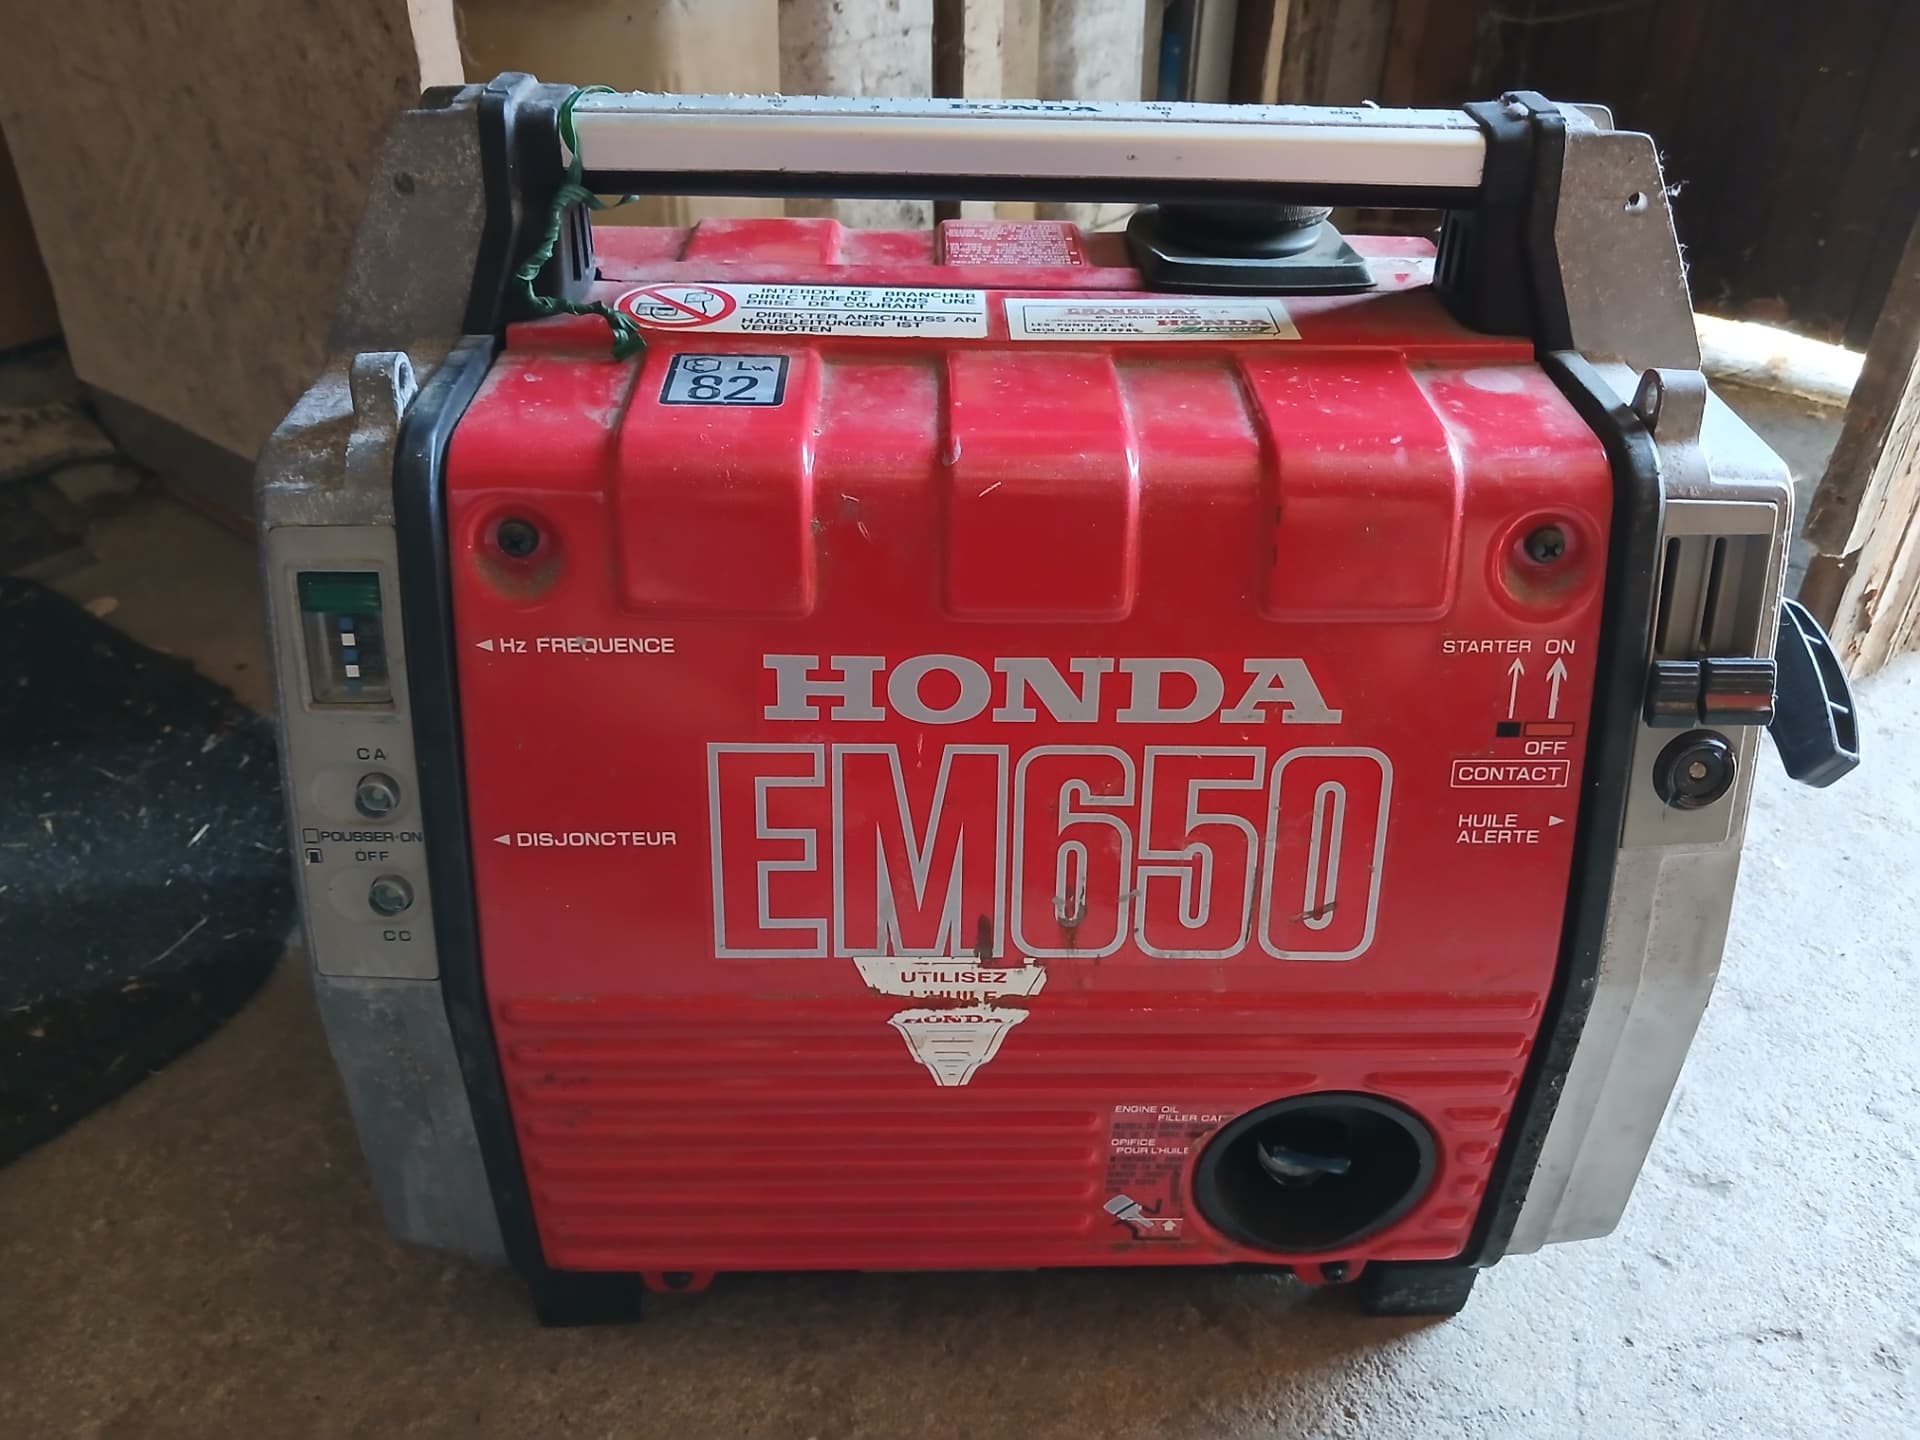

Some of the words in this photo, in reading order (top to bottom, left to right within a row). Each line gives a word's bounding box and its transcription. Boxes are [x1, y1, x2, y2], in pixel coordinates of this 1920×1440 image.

[949, 104, 1101, 112] HONDA
[748, 293, 868, 302] DIRECTEMENT
[742, 318, 885, 327] HAUSLEITUNGEN
[846, 314, 946, 323] ANSCHLUSS
[741, 324, 832, 332] VERBOTEN
[687, 375, 759, 400] 82
[499, 638, 527, 653] Hz
[536, 637, 675, 654] FREQUENCE
[1442, 640, 1532, 653] STARTER
[1545, 639, 1575, 654] ON
[763, 654, 1342, 724] HONDA
[1524, 741, 1568, 755] OFF
[1458, 766, 1562, 781] CONTACT
[1458, 814, 1519, 828] HUILE
[516, 831, 677, 846] DISJONCTEUR
[1456, 829, 1540, 844] ALERTE
[355, 851, 389, 862] OFF
[707, 743, 1393, 960] EM650
[383, 930, 412, 942] CC
[901, 972, 1007, 983] UTILISEZ
[1115, 1105, 1157, 1113] ENGINE
[1161, 1105, 1179, 1113] OIL
[1111, 1138, 1156, 1146] ORIFICE
